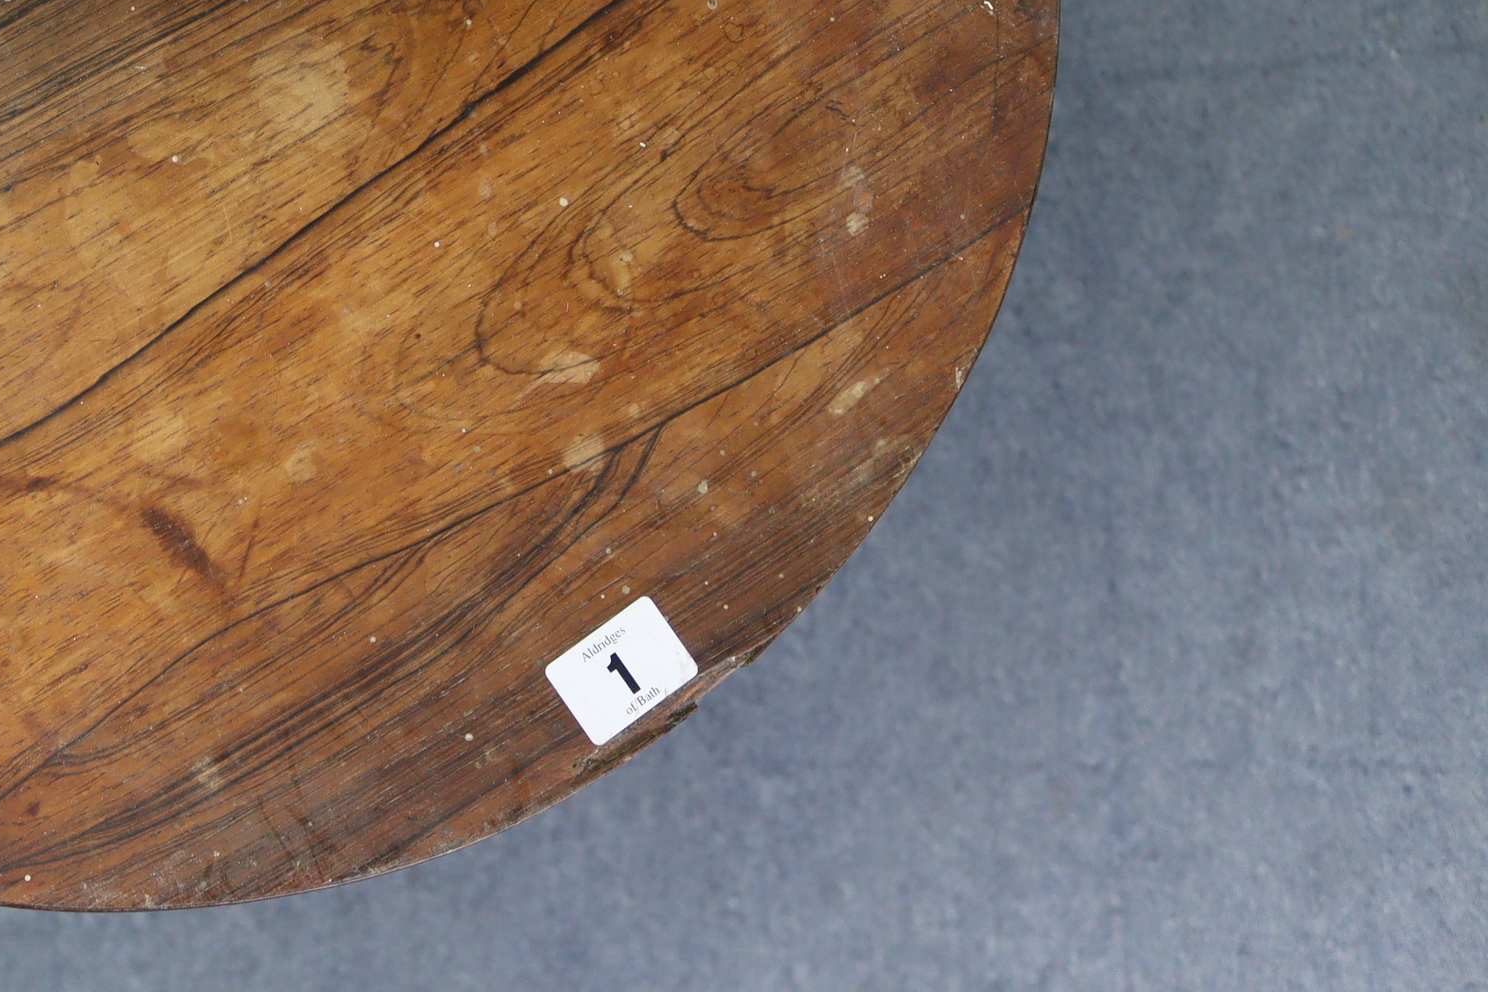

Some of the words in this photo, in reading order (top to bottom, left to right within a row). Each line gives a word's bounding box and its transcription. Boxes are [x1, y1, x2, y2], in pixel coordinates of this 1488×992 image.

[582, 627, 626, 663] Aldridges
[606, 652, 641, 695] 1
[626, 701, 638, 715] of
[637, 686, 661, 707] Bath
